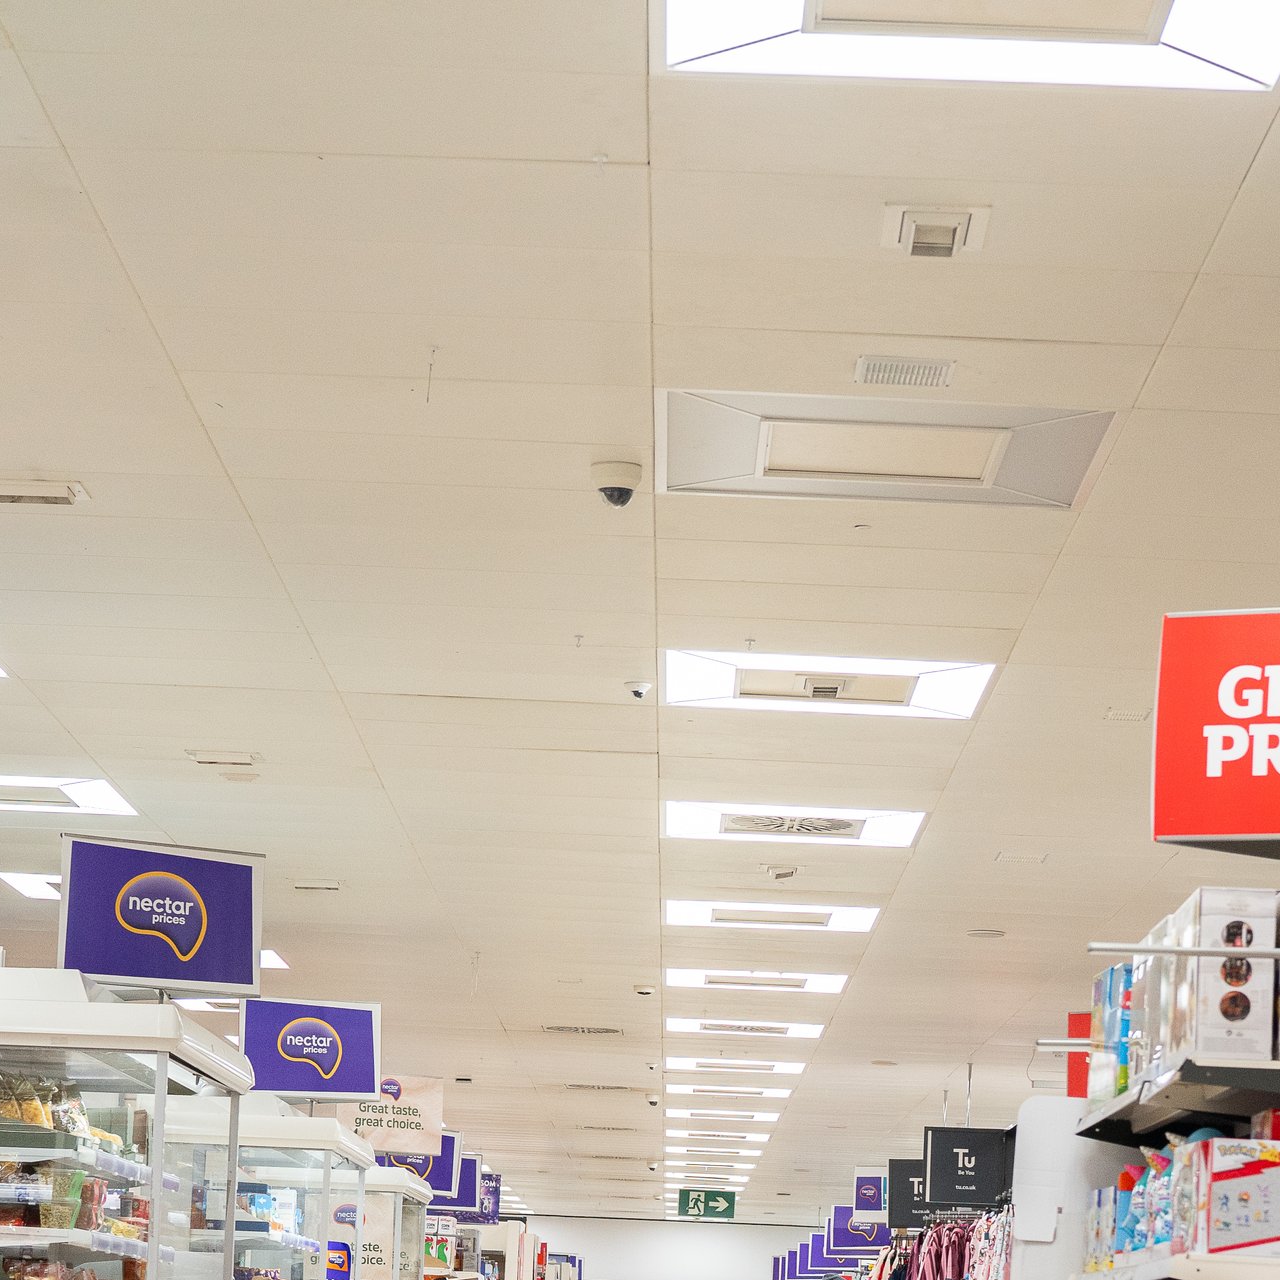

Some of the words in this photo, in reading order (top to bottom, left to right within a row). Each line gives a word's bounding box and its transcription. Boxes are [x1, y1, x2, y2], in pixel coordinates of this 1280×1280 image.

[128, 896, 194, 916] nectar
[152, 912, 186, 925] prices
[287, 1032, 332, 1049] nectar
[303, 1045, 328, 1056] prices
[358, 1102, 388, 1115] Great
[392, 1105, 421, 1118] taste,
[354, 1117, 384, 1128] great
[386, 1118, 424, 1130] choice.
[953, 1148, 976, 1168] Tu
[351, 1242, 383, 1254] tste,
